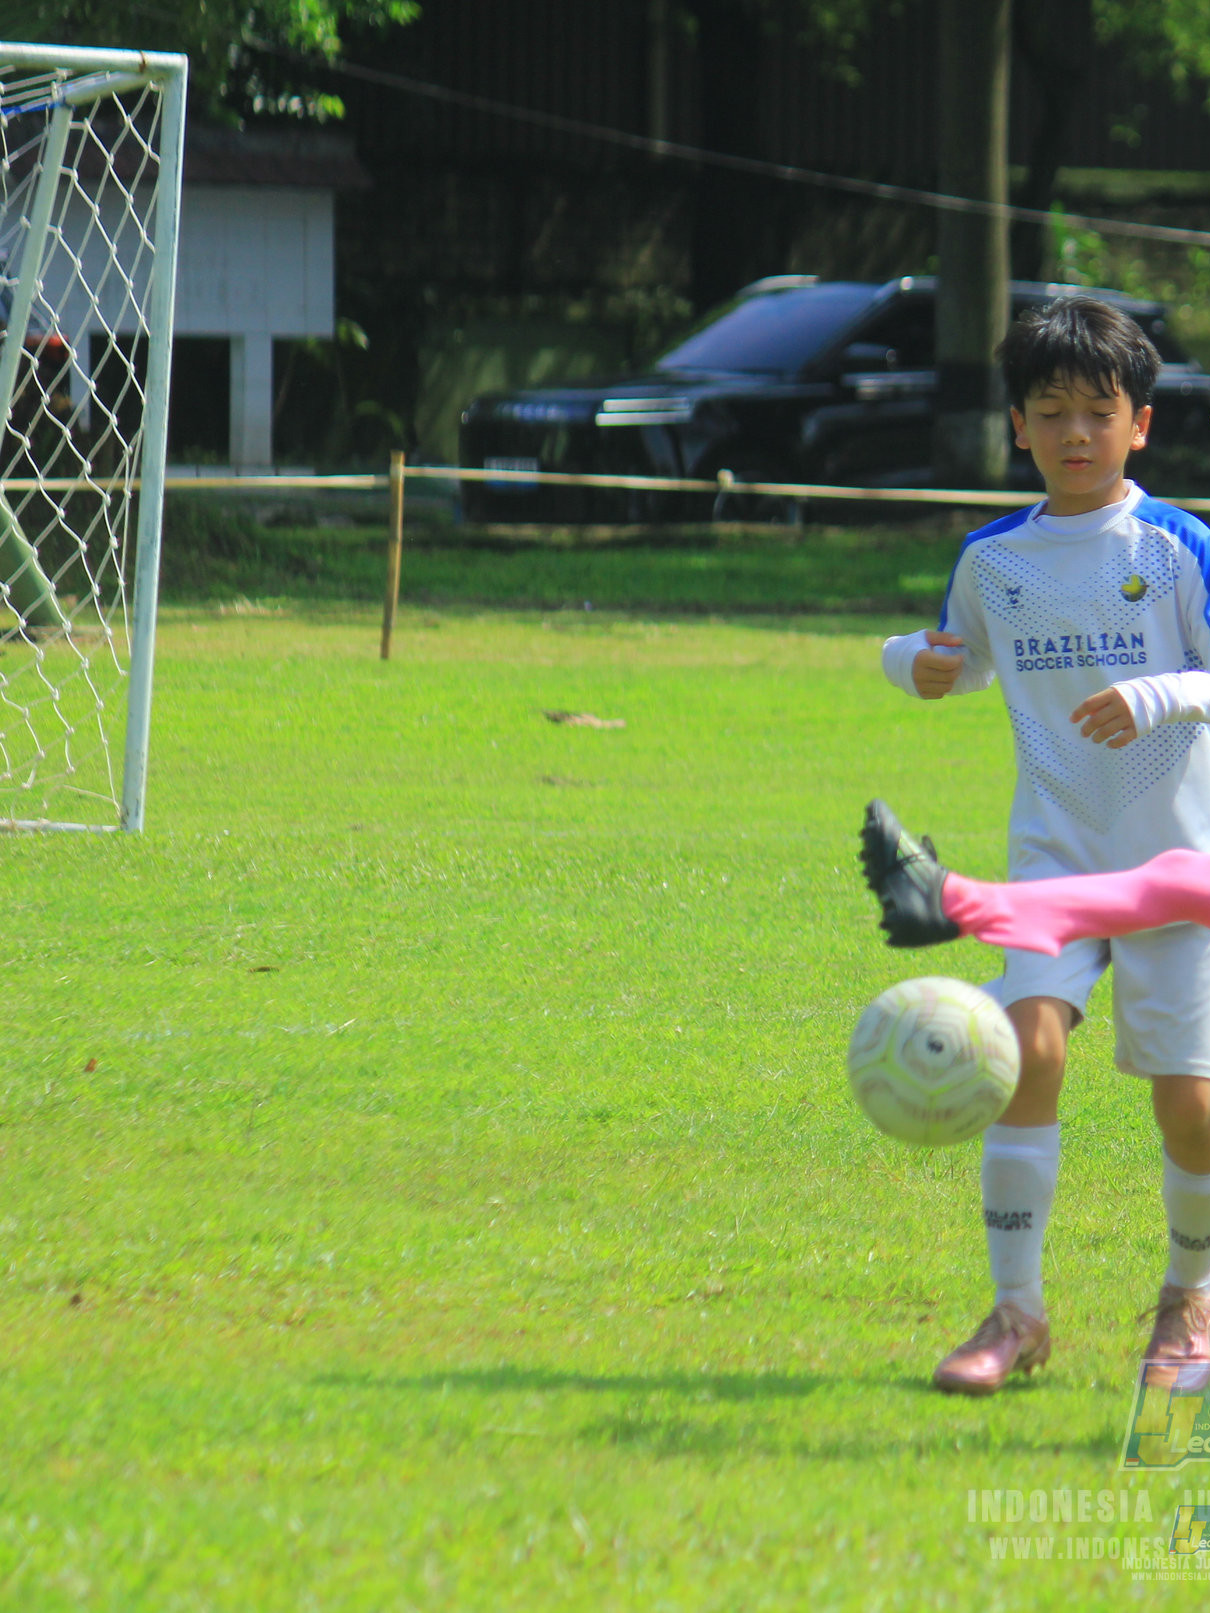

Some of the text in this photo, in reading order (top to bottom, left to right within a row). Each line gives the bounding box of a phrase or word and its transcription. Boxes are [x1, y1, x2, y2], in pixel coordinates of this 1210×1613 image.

[1014, 632, 1145, 656] BRAZILIAN
[1016, 651, 1147, 672] SOCCER SCHOOLS
